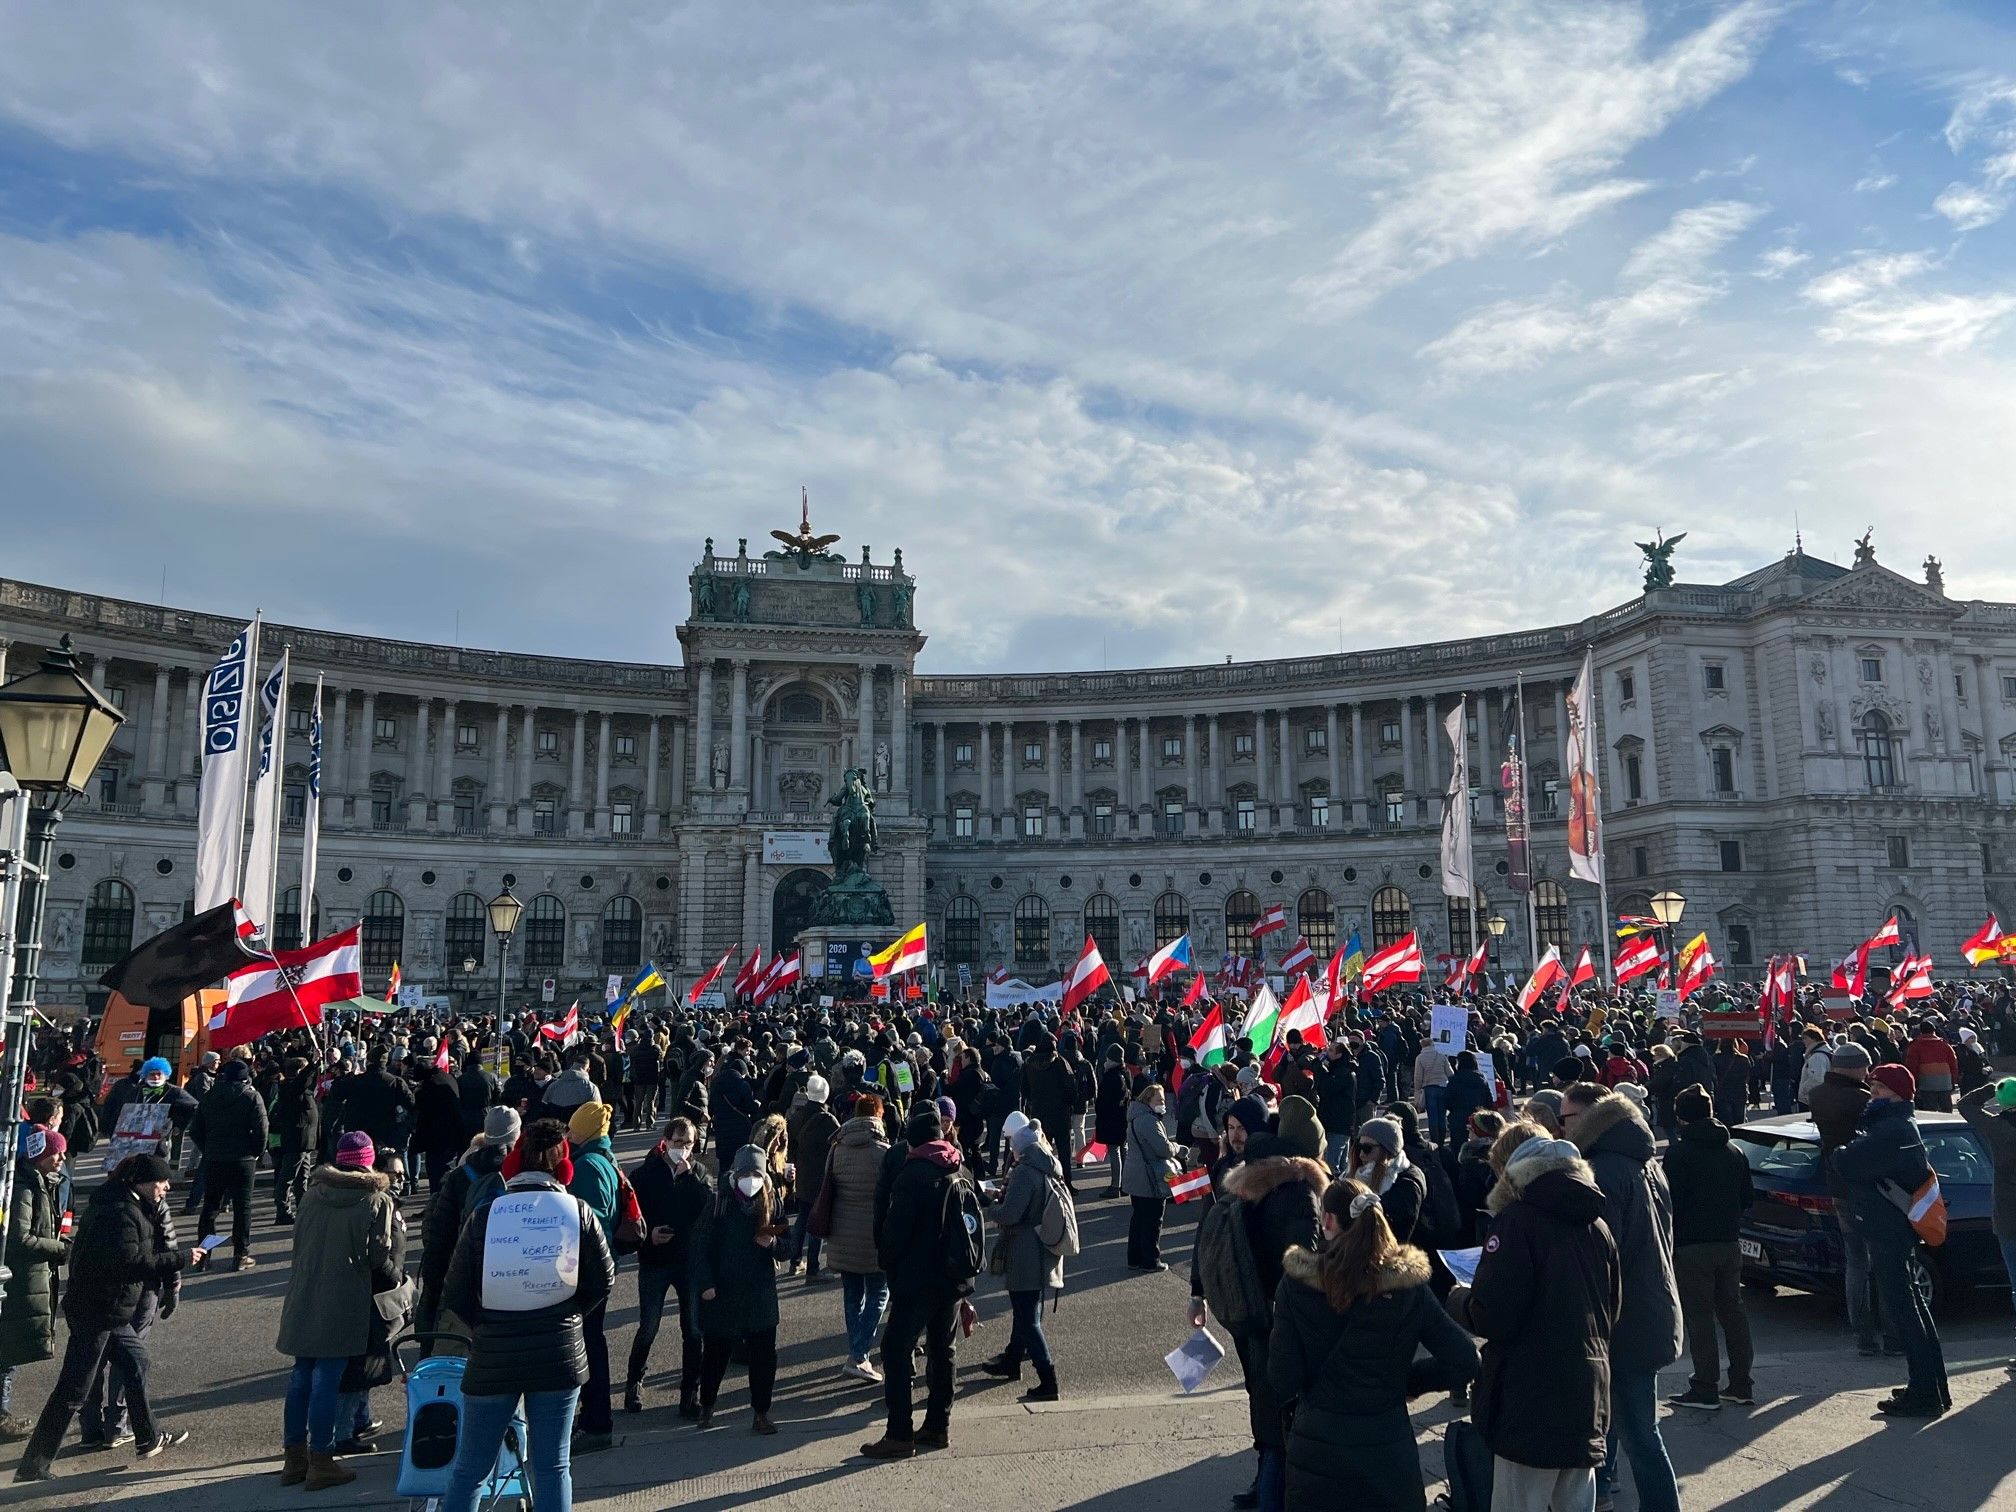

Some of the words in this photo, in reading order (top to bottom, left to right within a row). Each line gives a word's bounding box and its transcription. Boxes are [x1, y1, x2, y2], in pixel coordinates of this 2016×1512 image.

[828, 944, 847, 954] 2020
[494, 1204, 534, 1214] UNSERE
[490, 1236, 520, 1245] UNSER
[491, 1269, 529, 1277] UNSERE
